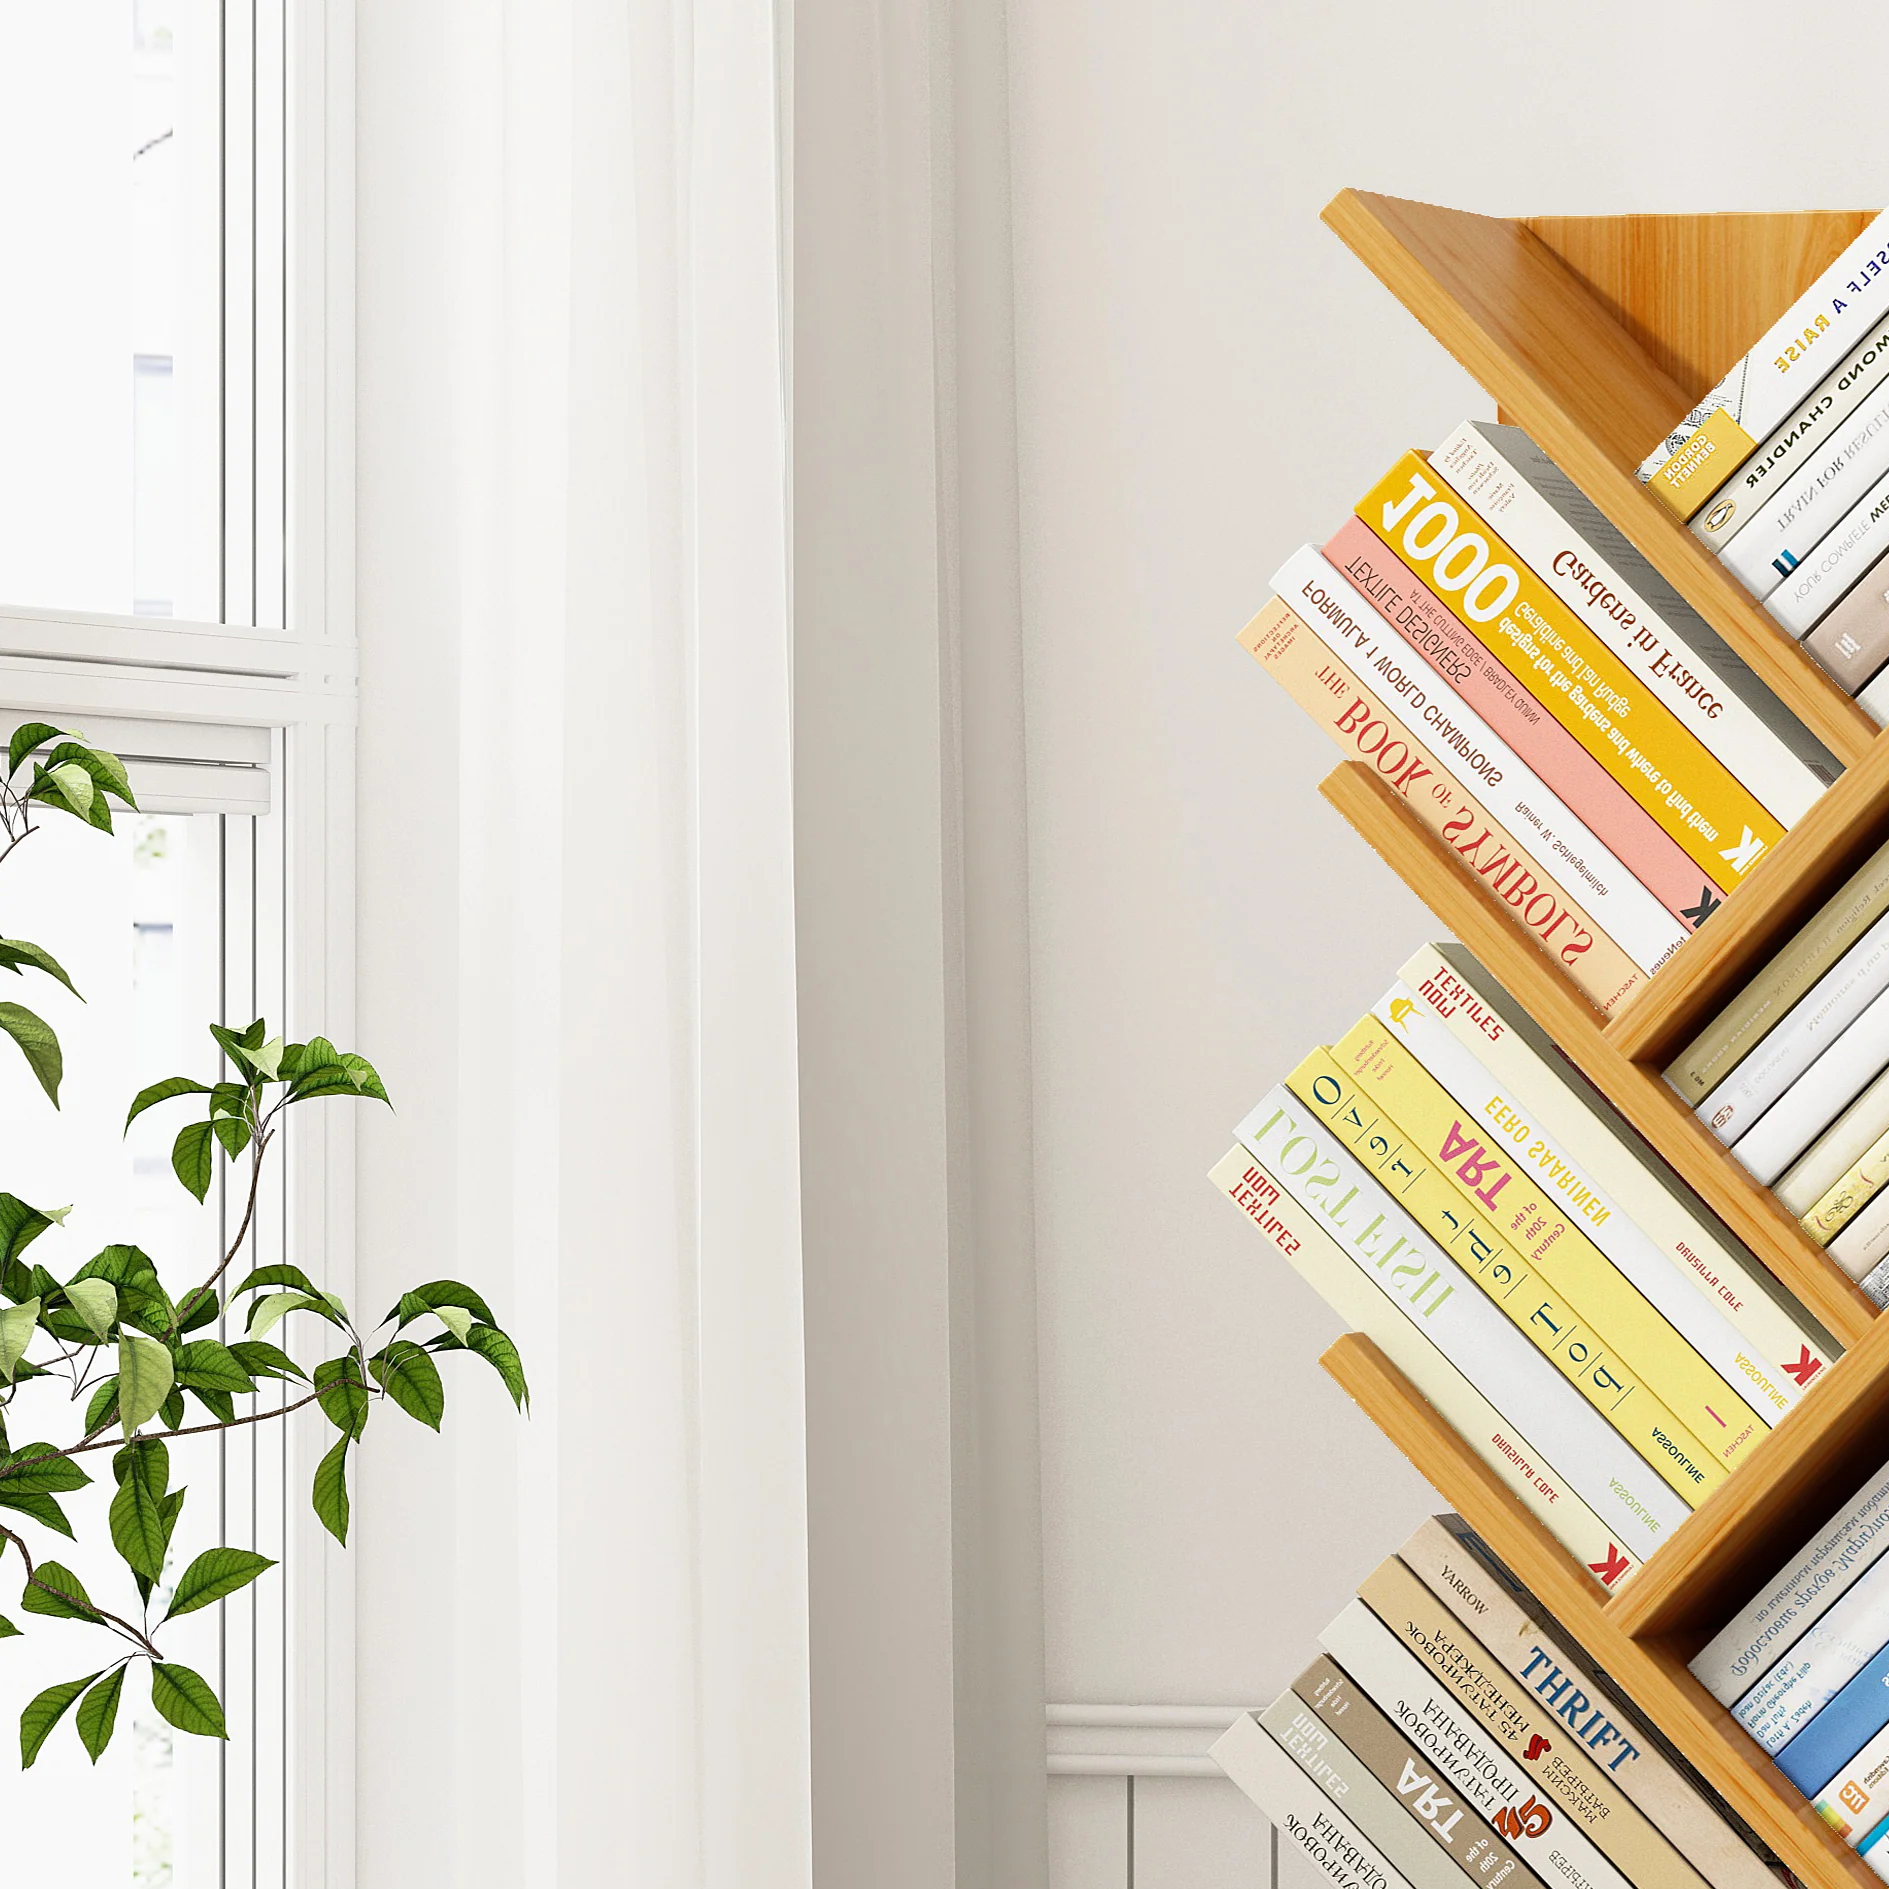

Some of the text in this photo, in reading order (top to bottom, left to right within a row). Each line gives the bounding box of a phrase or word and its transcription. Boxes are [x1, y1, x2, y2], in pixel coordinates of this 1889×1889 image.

[1417, 978, 1457, 1019] NOW
[1432, 964, 1505, 1042] TEXTILES
[1674, 1240, 1744, 1312] DRUSILLA COLE
[1440, 1563, 1489, 1615] YARROW
[1404, 1620, 1518, 1741] 45 ТАТУИРОВОК
[1433, 1628, 1530, 1733] МЕНЕДЖЕРА
[1518, 1644, 1641, 1772] THRIFT
[1393, 1699, 1495, 1811] ТАТУИРОВОК
[1421, 1697, 1519, 1803] ПРОДАВАНА
[1550, 1755, 1611, 1820] БАТЫРЕВ
[1541, 1764, 1598, 1824] МАКСИМ
